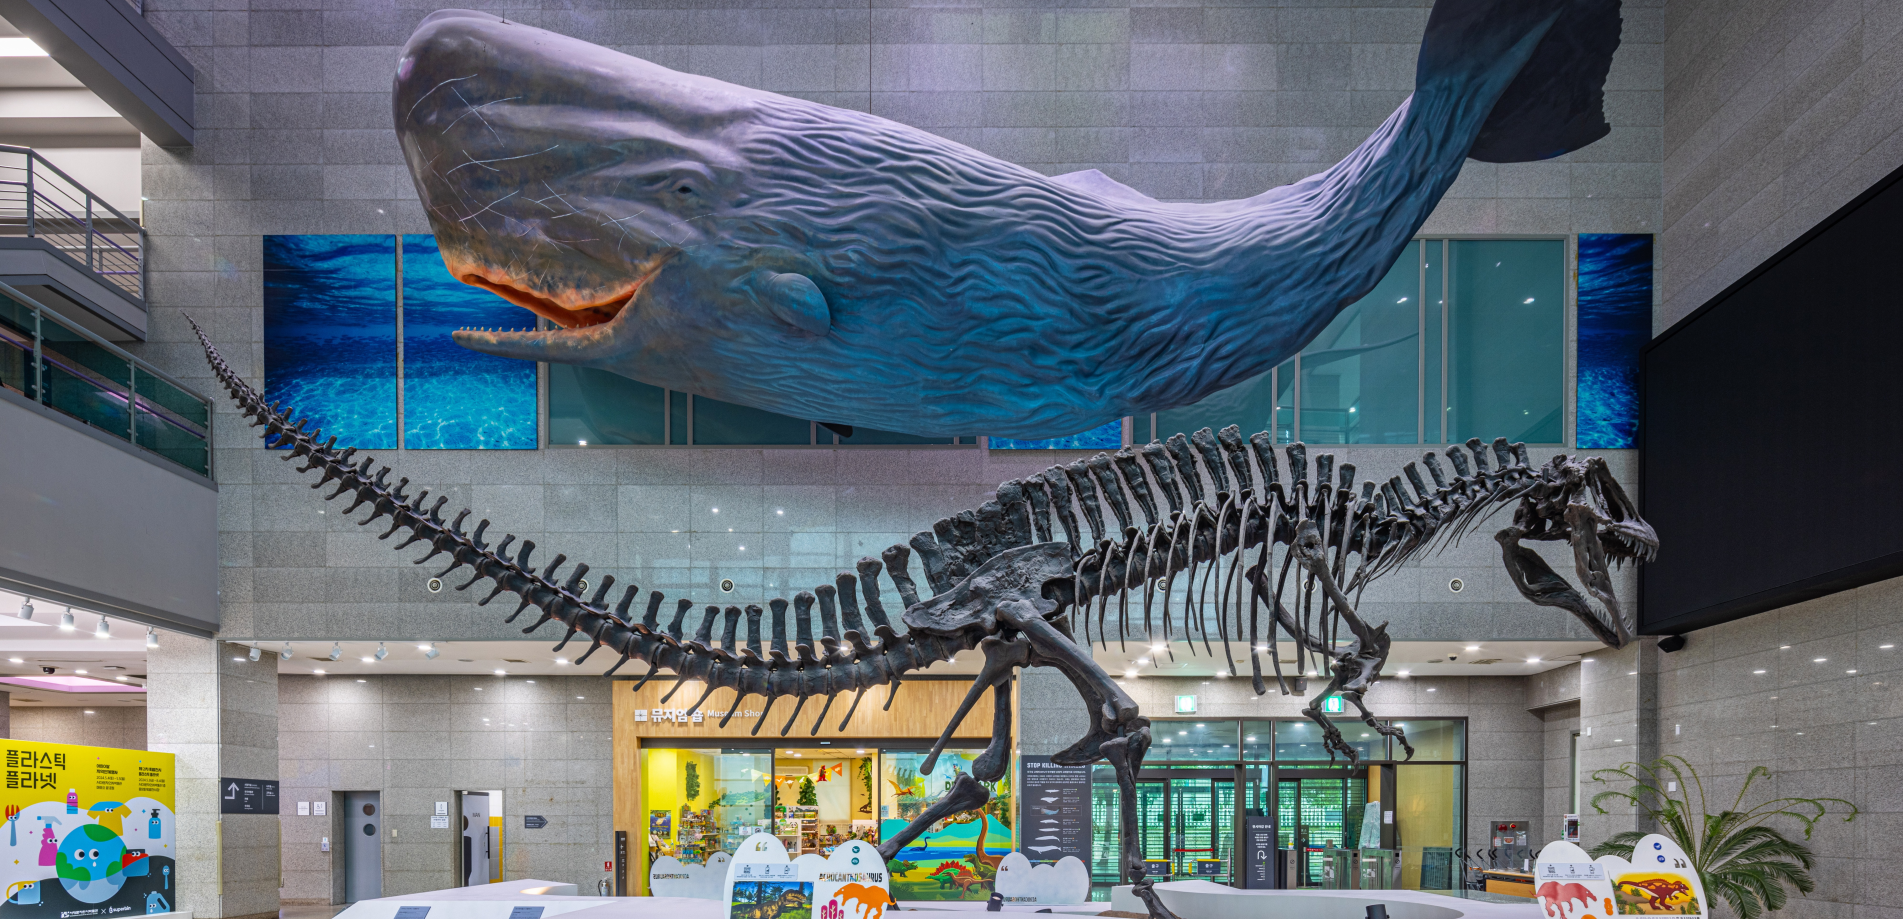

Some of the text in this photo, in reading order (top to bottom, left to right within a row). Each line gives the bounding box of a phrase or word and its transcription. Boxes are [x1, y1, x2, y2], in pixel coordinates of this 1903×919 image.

[651, 708, 688, 723] 뮤지엄
[707, 709, 743, 718] Musem
[6, 749, 66, 771] 플라스틱
[6, 770, 57, 790] 플라넷
